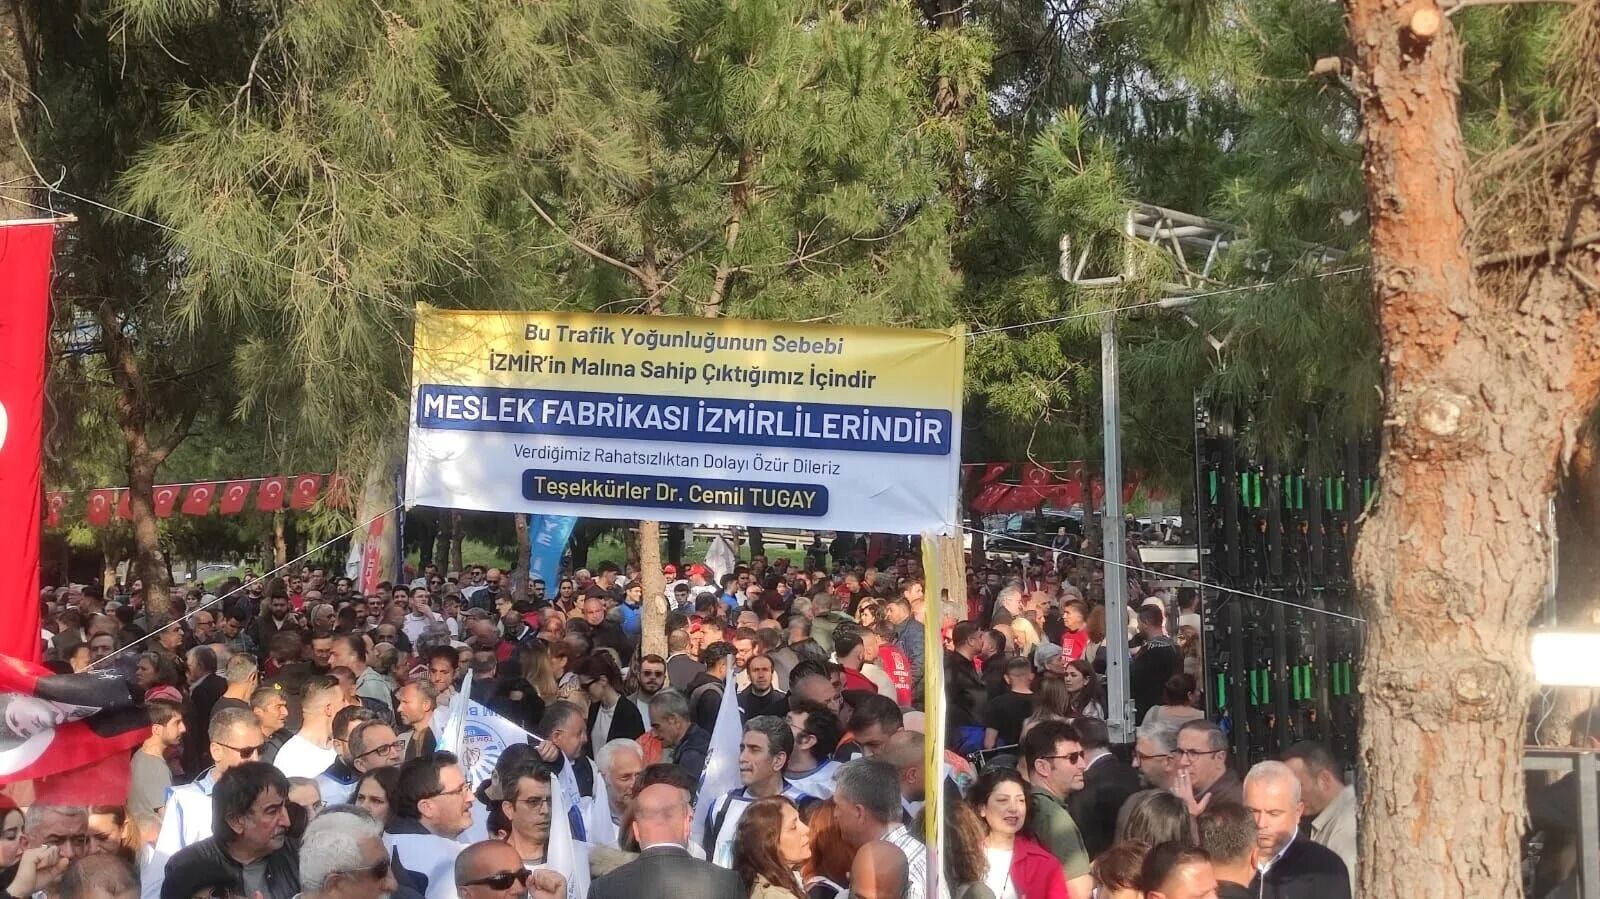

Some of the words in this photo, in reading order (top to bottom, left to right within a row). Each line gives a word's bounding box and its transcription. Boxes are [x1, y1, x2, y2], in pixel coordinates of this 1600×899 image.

[524, 323, 550, 341] Bu
[556, 324, 615, 345] Trafik
[621, 327, 767, 353] Yoğunluğunun
[772, 334, 844, 355] Sebebi
[571, 357, 636, 377] Malına
[640, 360, 697, 384] Sahip
[702, 363, 804, 388] Çıktığımız
[809, 363, 876, 390] İçindir
[423, 393, 536, 424] MESLEK
[541, 396, 689, 431] FABRİKASI
[697, 400, 943, 445] İZMİRLİLERİNDİR
[513, 443, 591, 464] Verdiğimiz
[594, 448, 699, 468] Rahatsızlıktan
[703, 453, 749, 474] Dolayı
[753, 452, 789, 473] Özür
[793, 458, 841, 475] Dileriz
[533, 475, 651, 499] Teşekkürler
[656, 483, 683, 502] Dr.
[688, 484, 744, 506] Cemil
[749, 487, 817, 509] TUGAY
